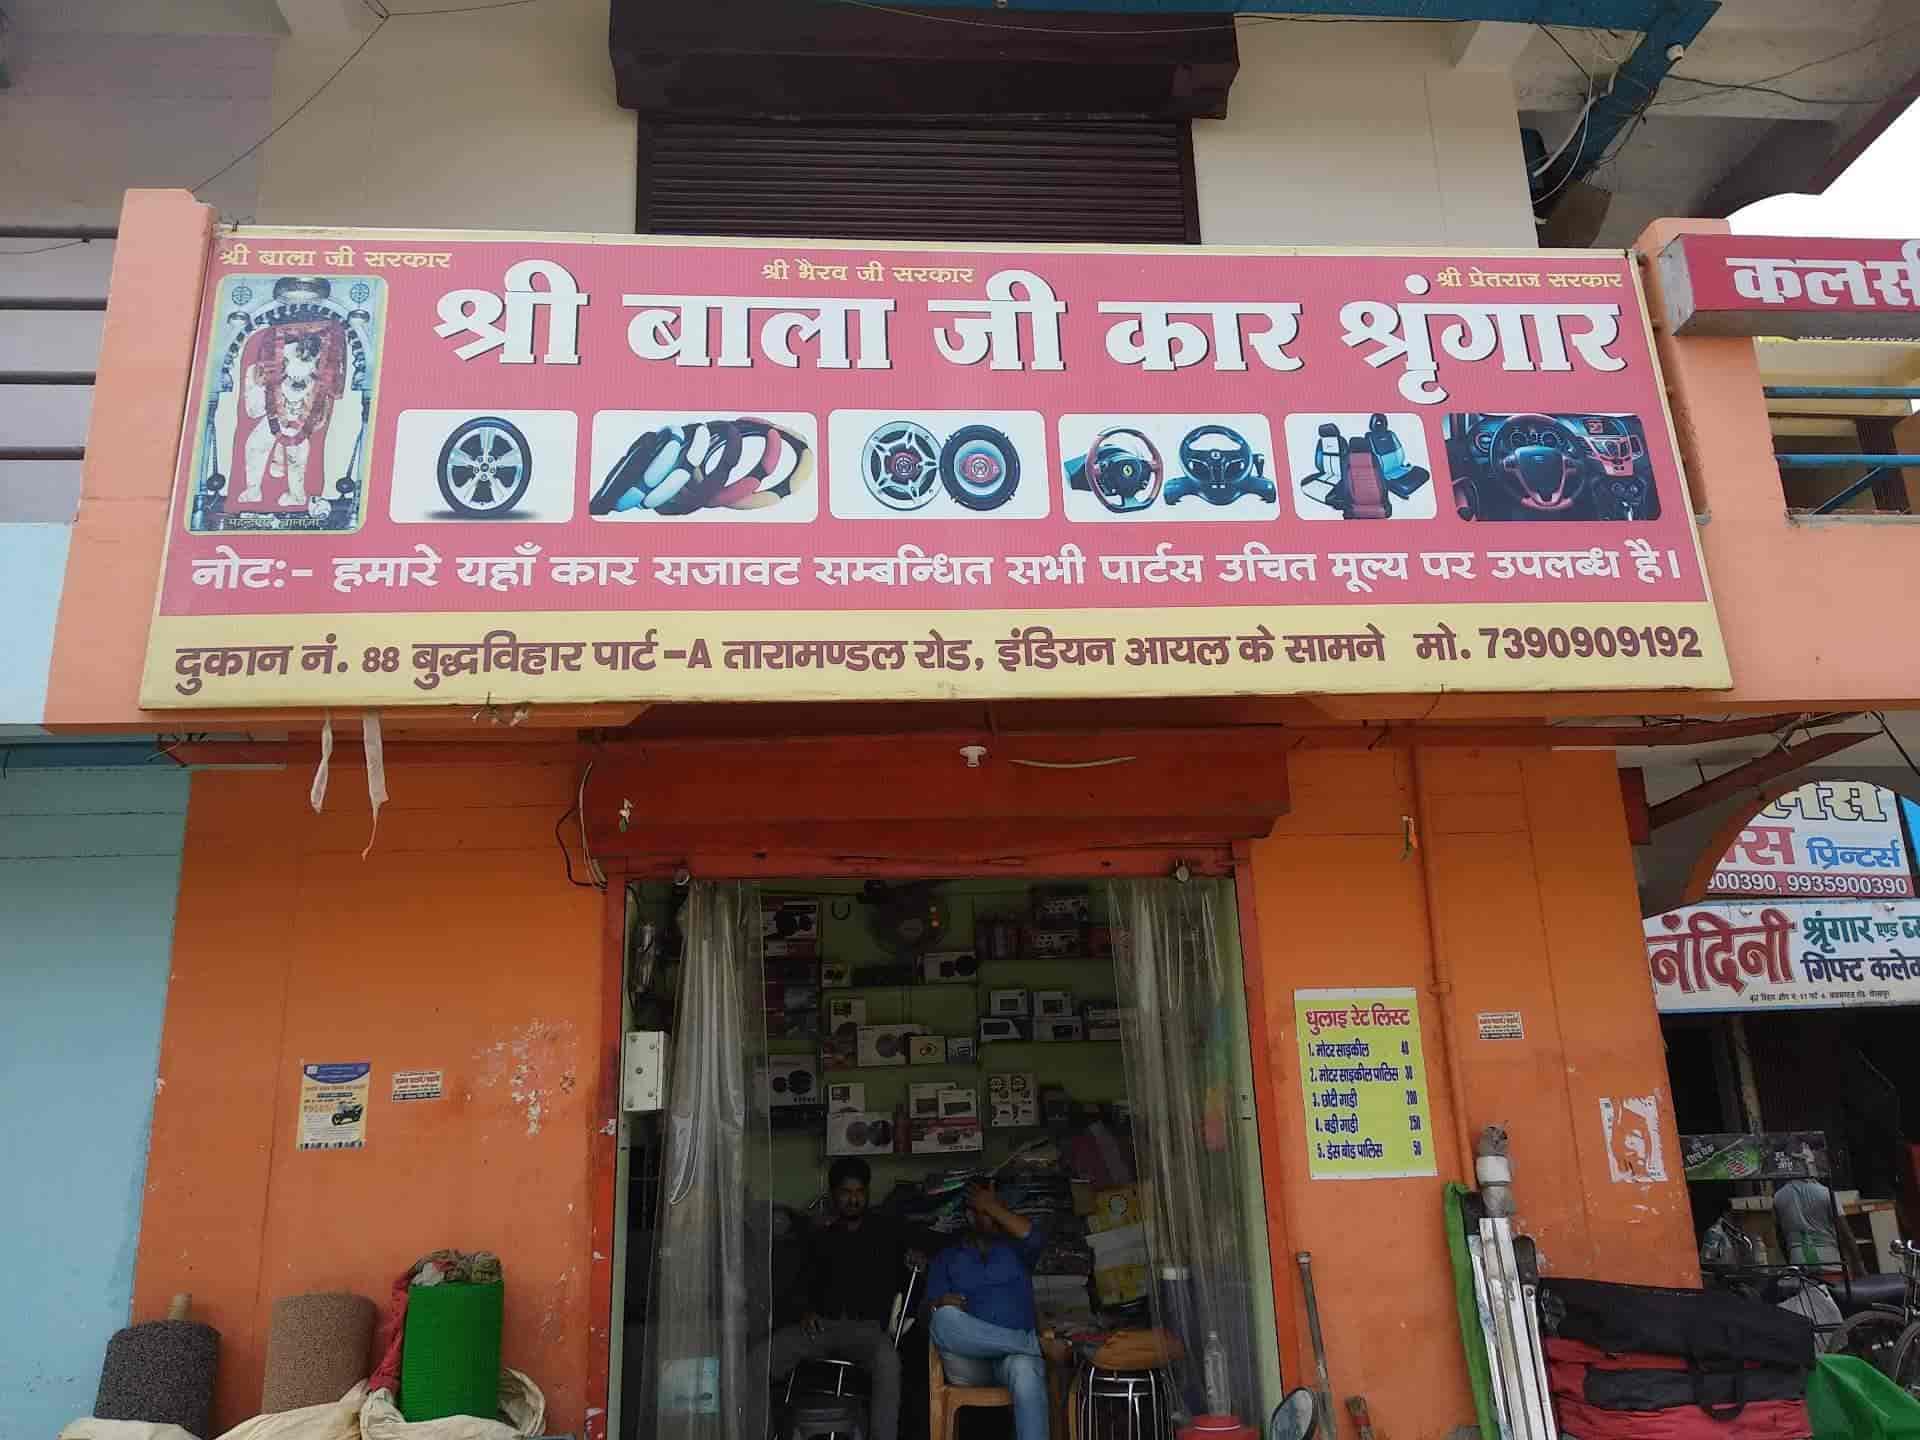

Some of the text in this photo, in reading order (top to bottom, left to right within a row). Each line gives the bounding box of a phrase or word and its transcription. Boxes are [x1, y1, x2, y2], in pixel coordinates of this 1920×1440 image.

[219, 243, 452, 268] श्री बाला जी सरकार
[761, 258, 976, 283] श्री भैरव जी सरकार
[1436, 267, 1623, 289] श्री प्रेतराज सरकार
[433, 259, 589, 368] श्री
[622, 294, 896, 370] बाला
[926, 269, 1067, 372] जी
[1098, 301, 1303, 372] कार
[332, 544, 442, 593] हमारे
[455, 541, 542, 592] यहाँ
[548, 557, 639, 587] कार
[653, 555, 801, 587] सजावट
[813, 544, 993, 586] सम्बन्धित
[1004, 543, 1086, 585] सभी
[1098, 542, 1204, 584] पार्टस
[1215, 541, 1317, 583] उचित
[1327, 552, 1408, 593] मूल्य
[1420, 551, 1476, 580] पर
[1487, 547, 1621, 580] उपलब्ध
[175, 645, 293, 695] दुकान
[301, 632, 348, 675] नं.
[362, 646, 400, 673] 88
[411, 630, 587, 691] बुद्धविहार
[722, 640, 908, 671] तारामण्डल
[914, 629, 985, 673] रोड,
[994, 626, 1116, 672] इंडियन
[1124, 636, 1230, 667] आयल
[1236, 624, 1275, 664] के
[1283, 622, 1385, 664] सामने
[1413, 622, 1471, 661] मो.
[1479, 626, 1703, 660] 7390909192
[1806, 837, 1901, 869] प्रिन्टर्स
[1787, 875, 1908, 894] 9935900390
[1646, 908, 1798, 995] नंदिनी
[1800, 952, 1864, 983] गिफ्ट
[1351, 1004, 1370, 1027] रेट
[1371, 1003, 1411, 1027] लिस्ट
